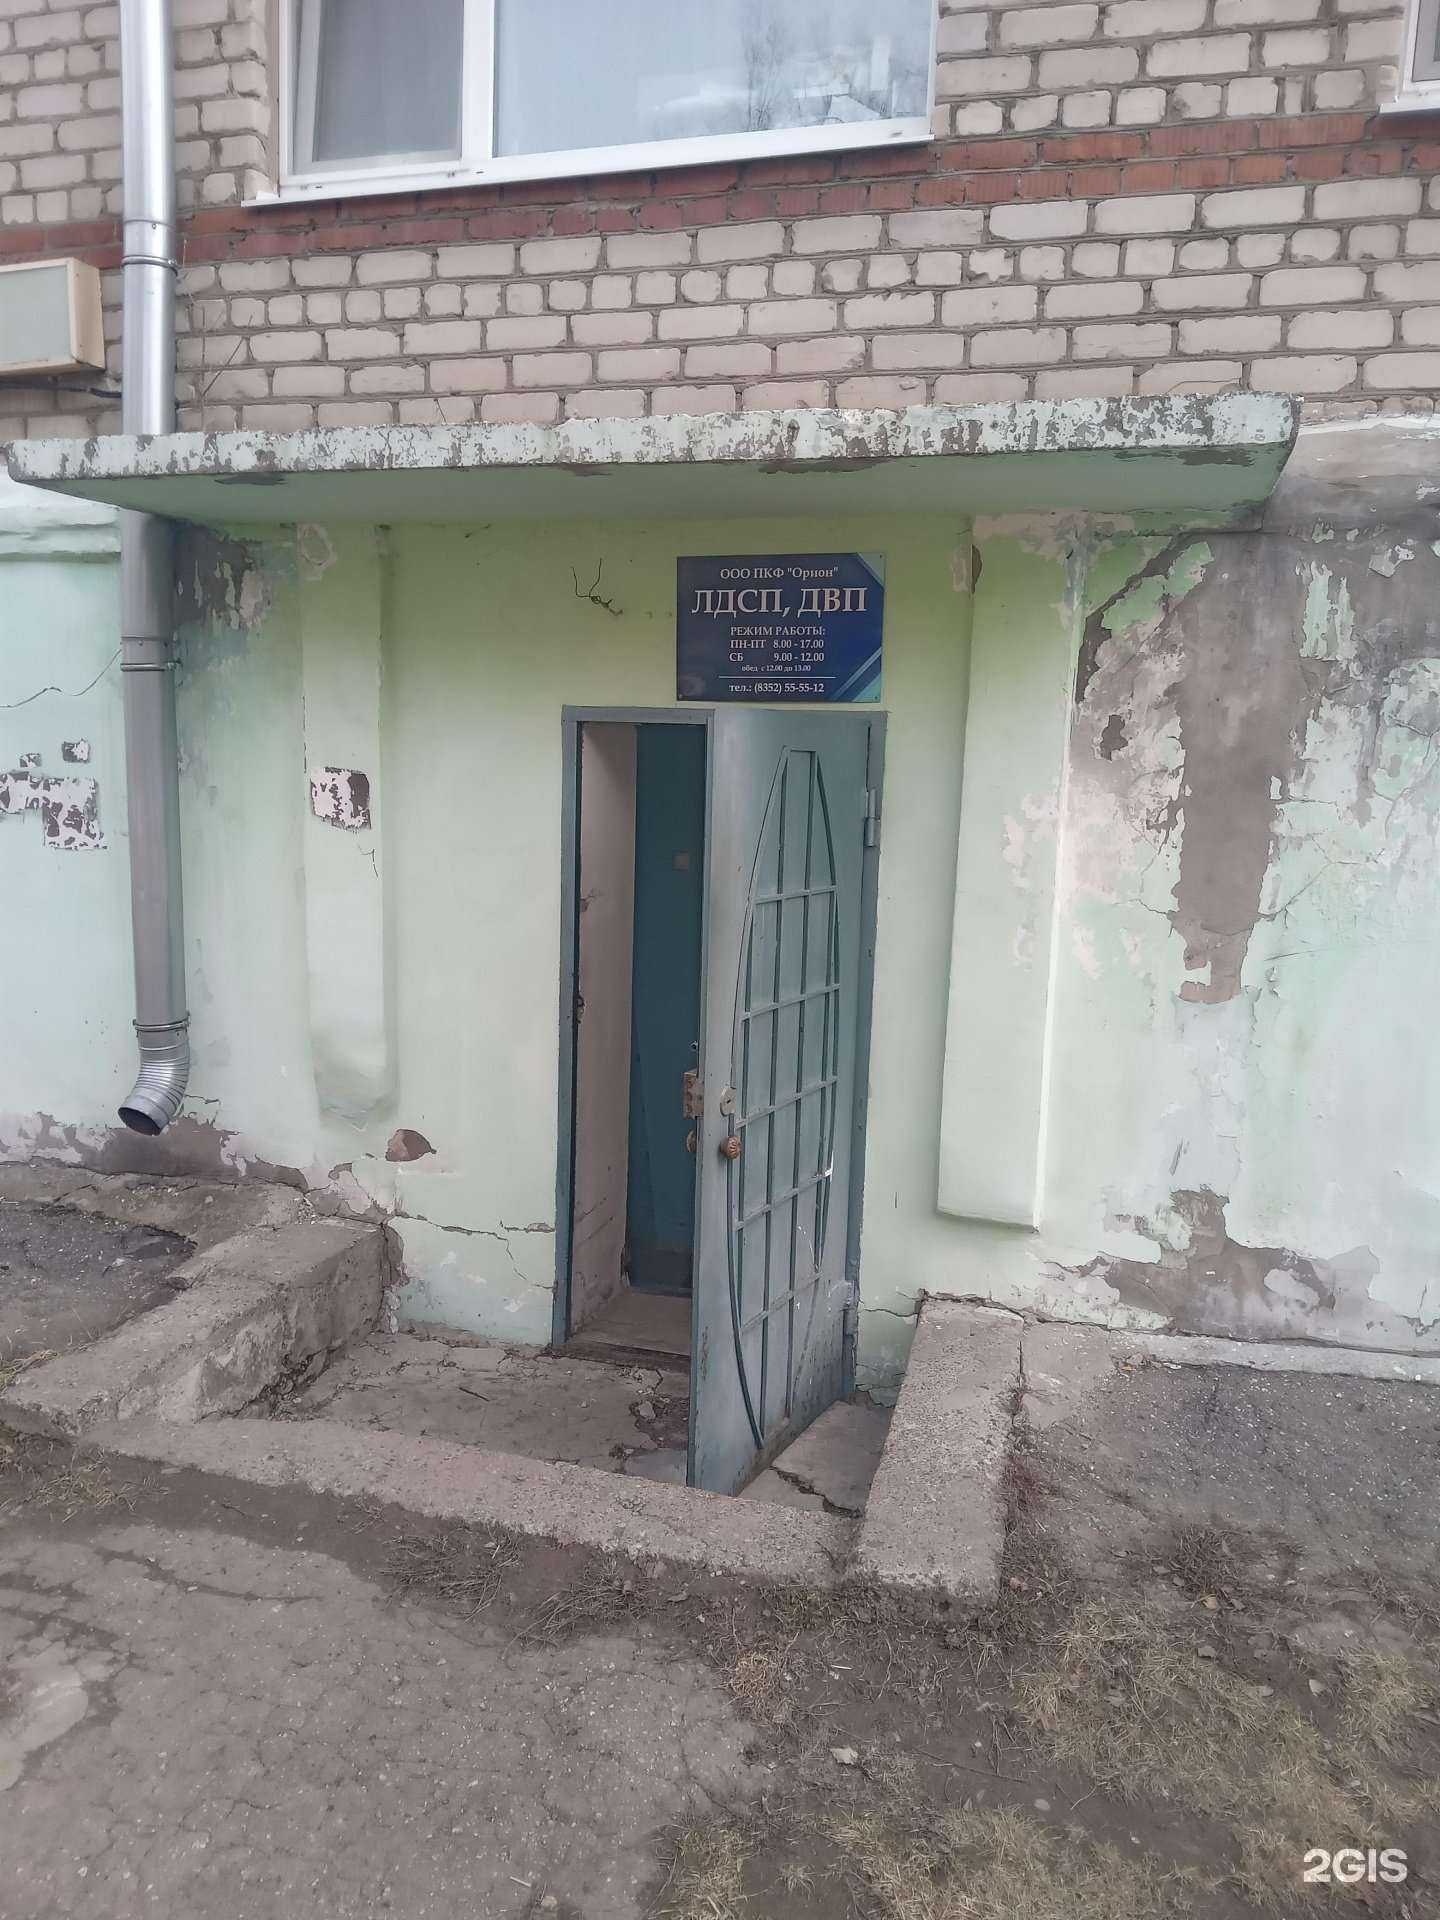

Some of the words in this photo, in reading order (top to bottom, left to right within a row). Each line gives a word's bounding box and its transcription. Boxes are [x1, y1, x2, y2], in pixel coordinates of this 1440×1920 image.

[720, 569, 750, 579] ООО
[754, 568, 784, 579] ПКФ
[788, 567, 838, 580] "Орион"
[692, 589, 791, 618] ЛДСП,
[797, 588, 868, 618] ДВП
[730, 627, 772, 636] РЕЖИМ
[775, 626, 825, 635] РАБОТЫ:
[730, 640, 766, 649] ПН-ПТ
[773, 640, 792, 648] 8.00
[800, 640, 824, 648] 17.00
[729, 653, 743, 661] СБ
[774, 653, 792, 661] 9.00
[800, 653, 824, 661] 12.00
[754, 683, 782, 694] (8352)
[784, 683, 824, 692] 55-55-12
